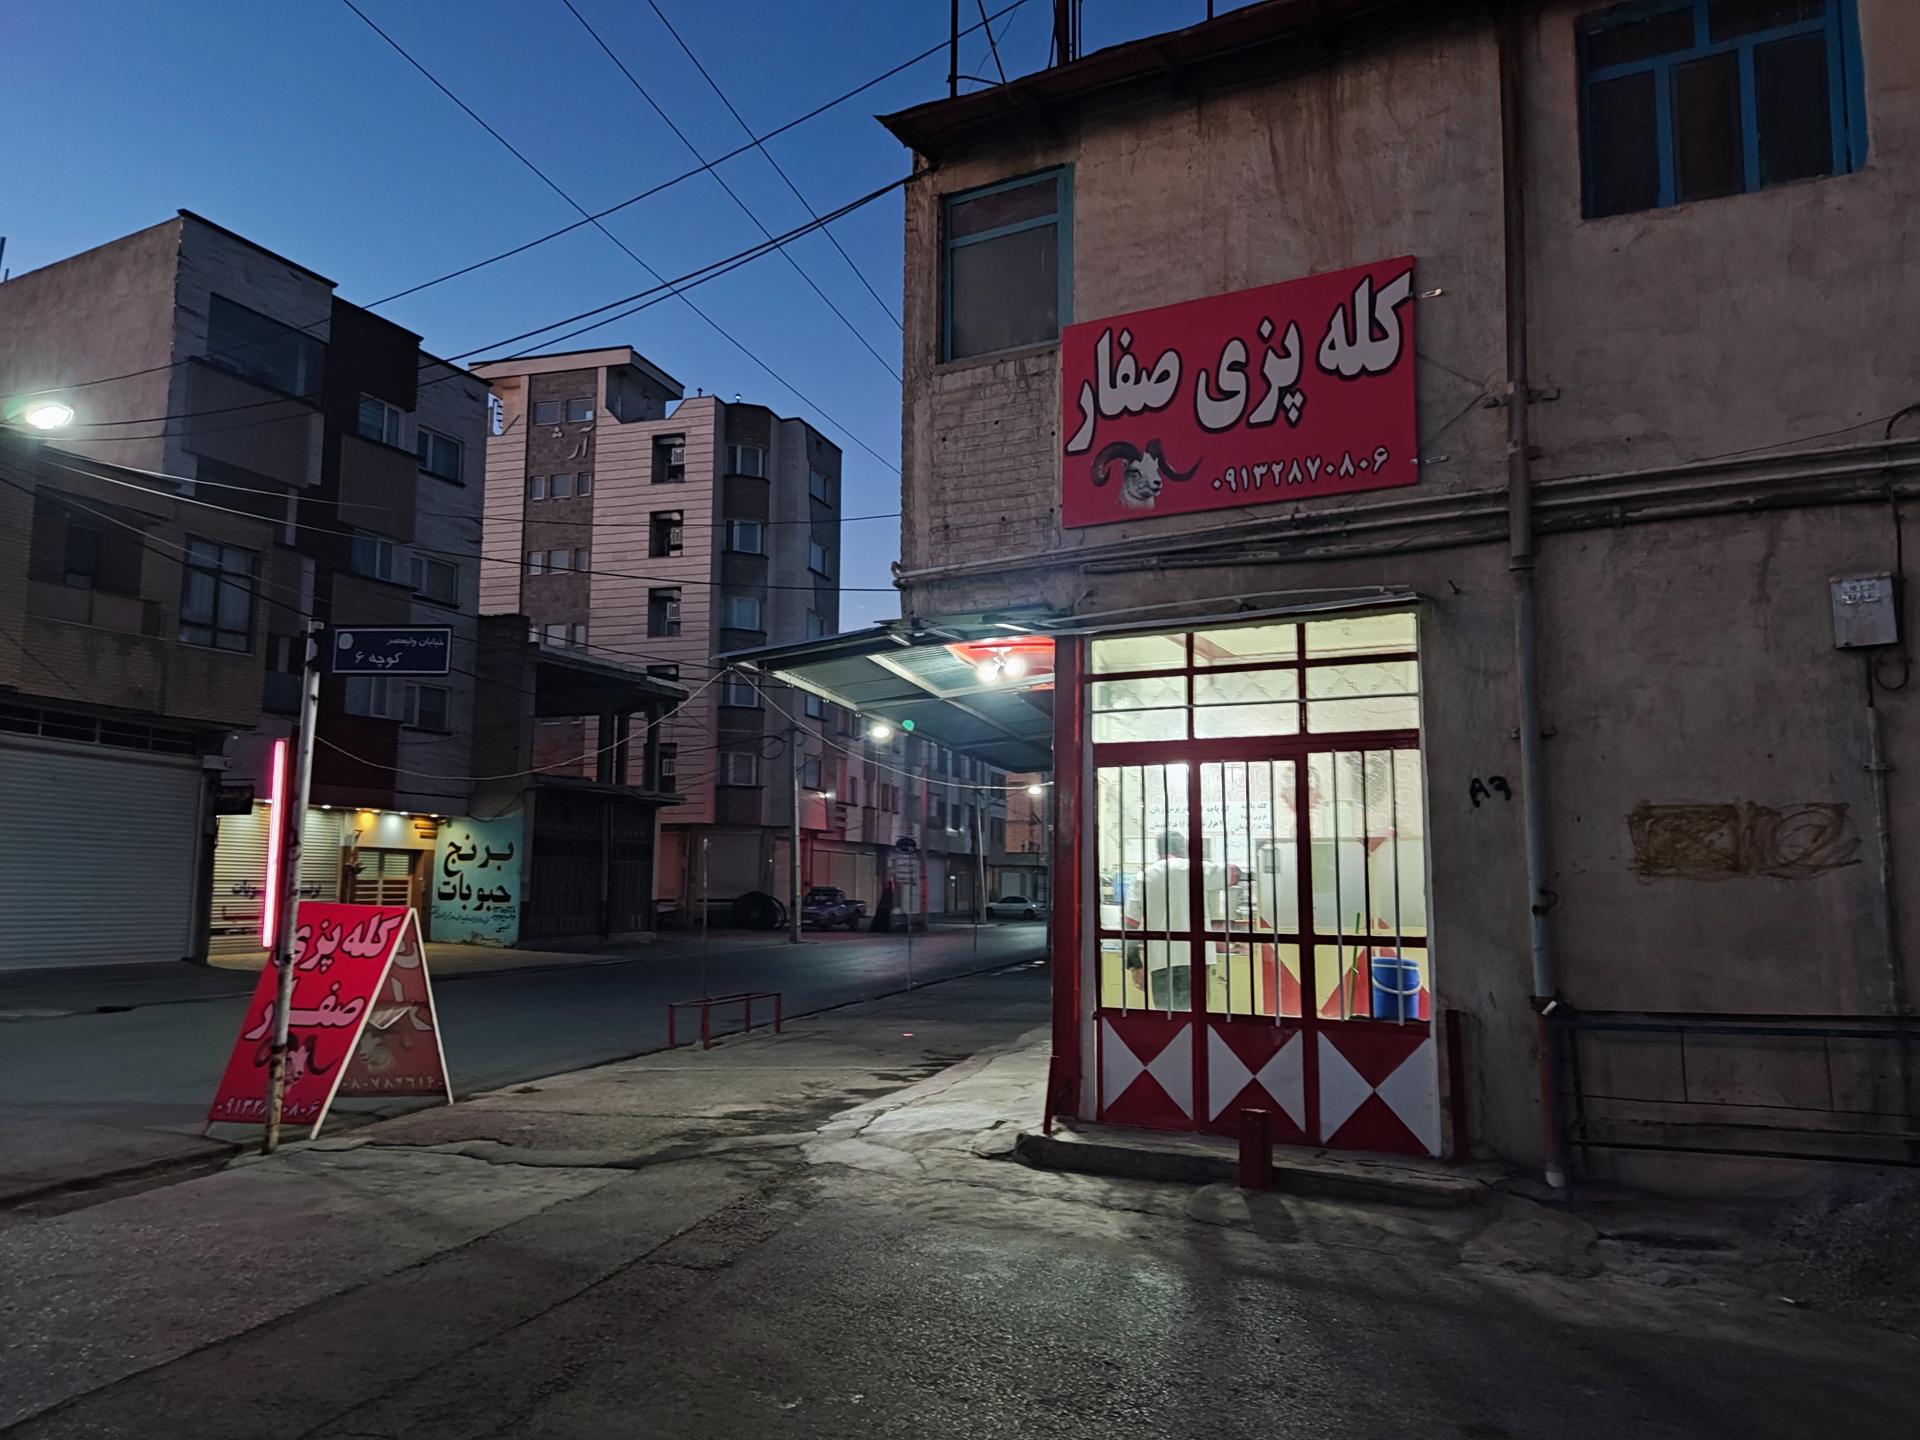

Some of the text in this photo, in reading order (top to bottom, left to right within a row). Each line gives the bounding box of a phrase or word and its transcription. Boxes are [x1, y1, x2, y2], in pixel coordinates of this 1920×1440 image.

[1066, 269, 1413, 456] کله پزی صفار
[1212, 445, 1390, 492] ۰۹۱۳۲۸۷۰۸۰۶
[354, 650, 403, 668] کوچه ۶
[418, 636, 445, 648] خیابان
[444, 833, 514, 877] برنج
[437, 873, 512, 911] حبوبات
[341, 913, 403, 958] کله
